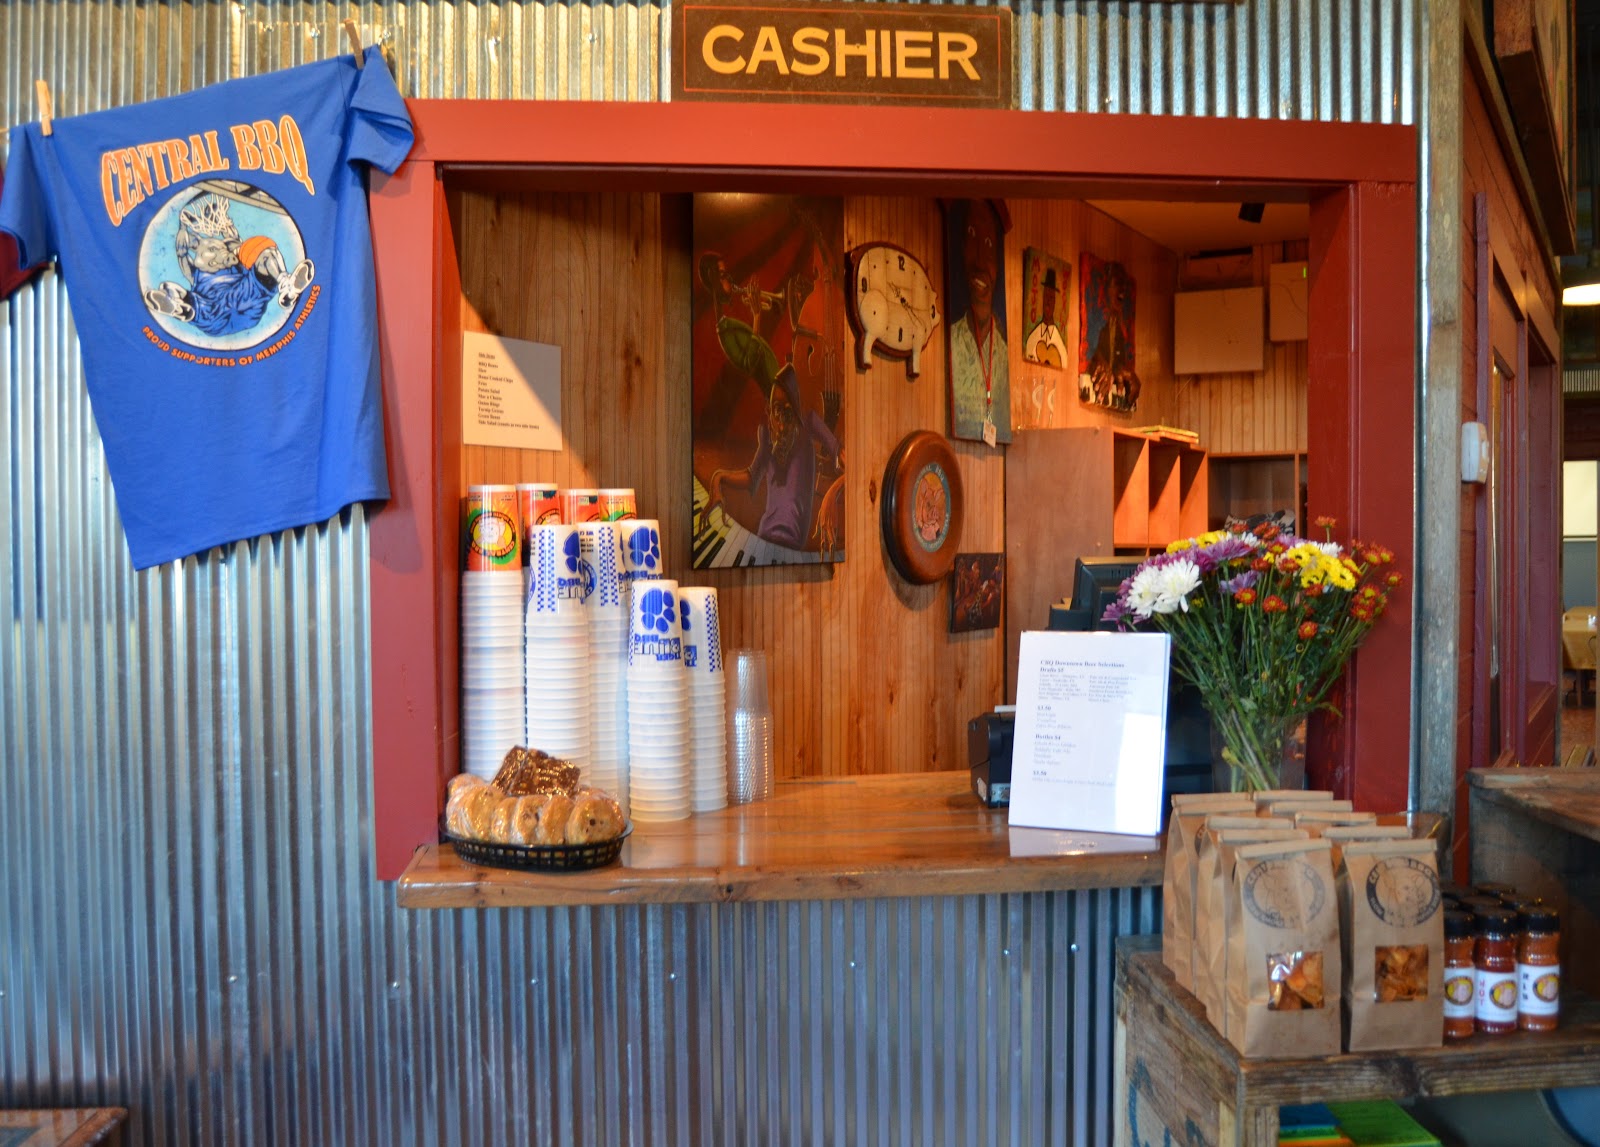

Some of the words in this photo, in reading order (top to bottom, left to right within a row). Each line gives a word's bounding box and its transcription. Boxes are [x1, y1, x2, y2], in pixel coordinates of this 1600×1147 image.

[702, 24, 981, 81] CASHIER
[101, 130, 230, 227] CENTRAL
[230, 114, 316, 196] BBQ
[1030, 255, 1040, 323] MOJO
[142, 325, 170, 353] PROUD
[170, 348, 236, 367] SUPPORTERS
[238, 354, 254, 365] OF
[255, 330, 296, 362] MEMPHIS
[294, 284, 321, 333] ATHLETICS
[656, 652, 681, 661] TIGER
